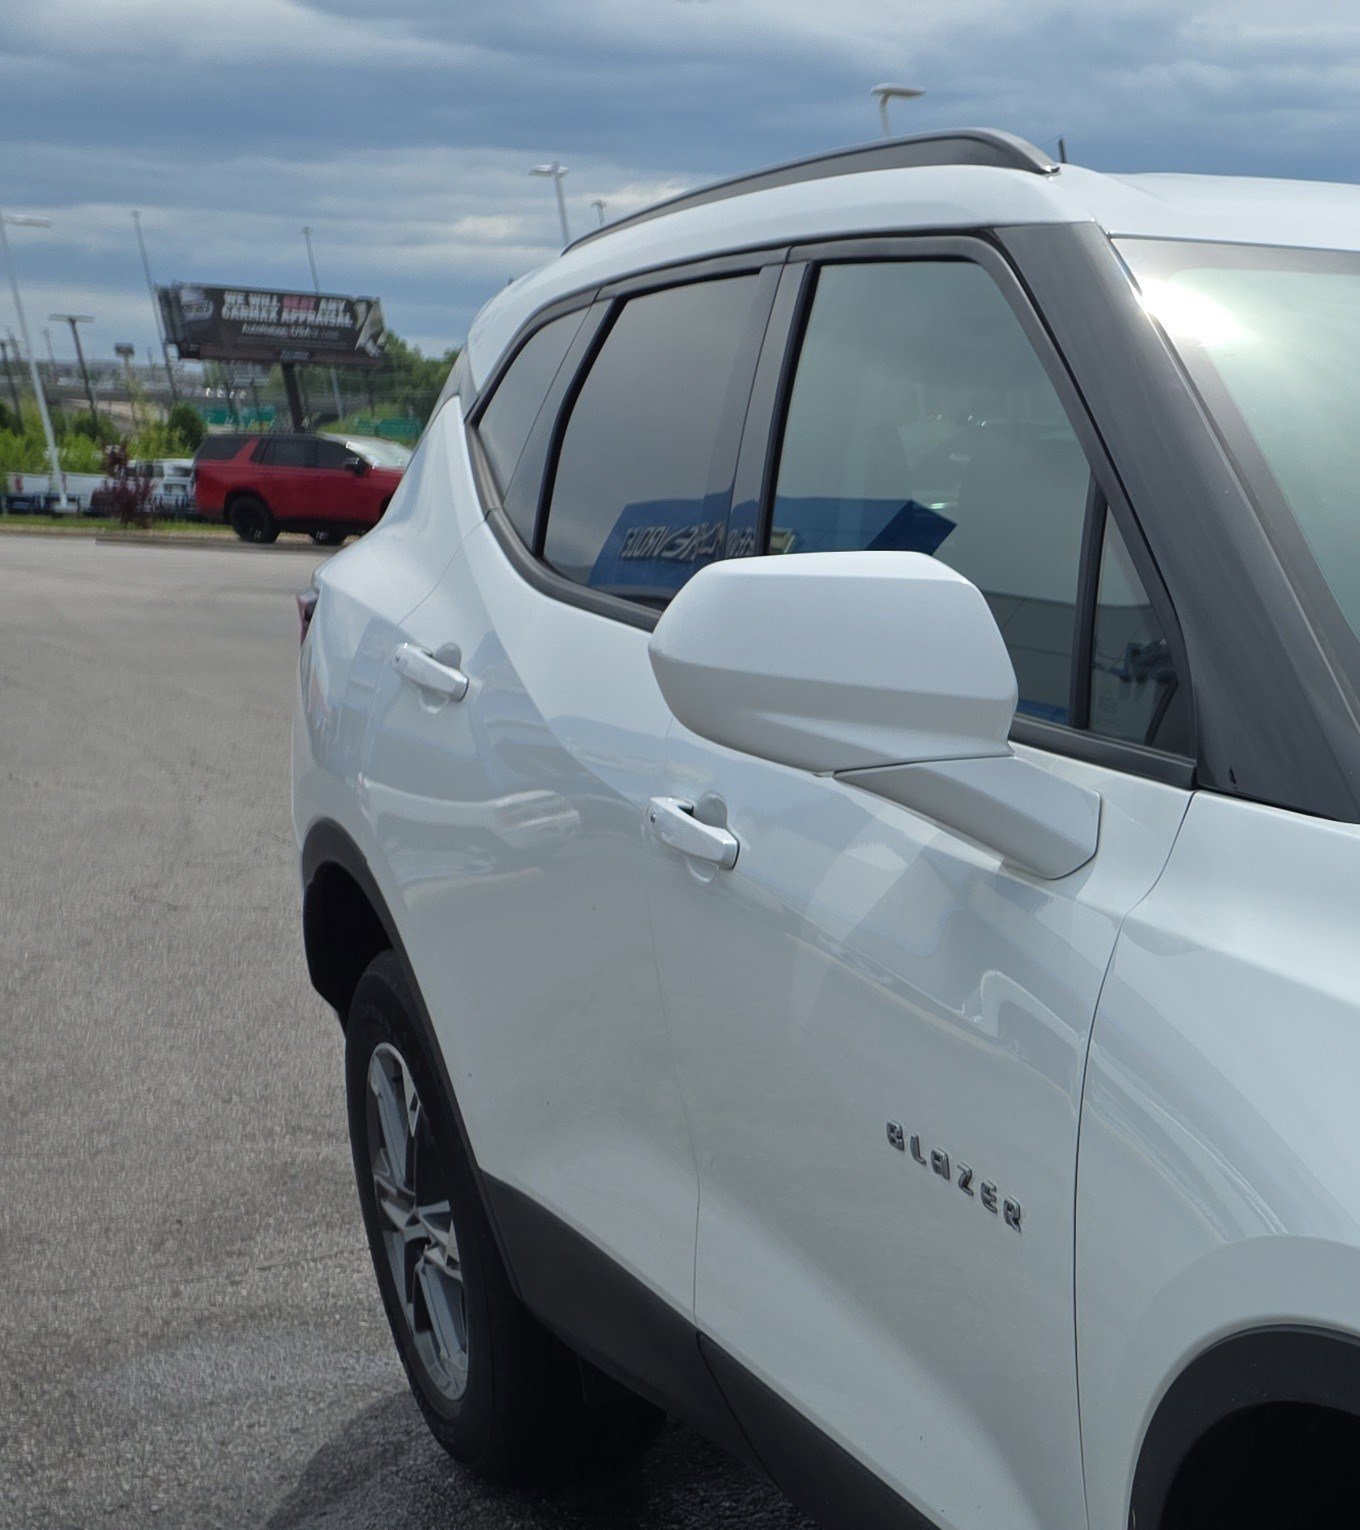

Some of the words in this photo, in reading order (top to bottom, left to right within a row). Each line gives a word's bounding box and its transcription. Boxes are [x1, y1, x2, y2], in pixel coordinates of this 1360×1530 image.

[223, 291, 246, 304] WE
[319, 297, 346, 312] ANY
[280, 308, 353, 328] APPRAISAL
[885, 1119, 1022, 1233] BLAZER
